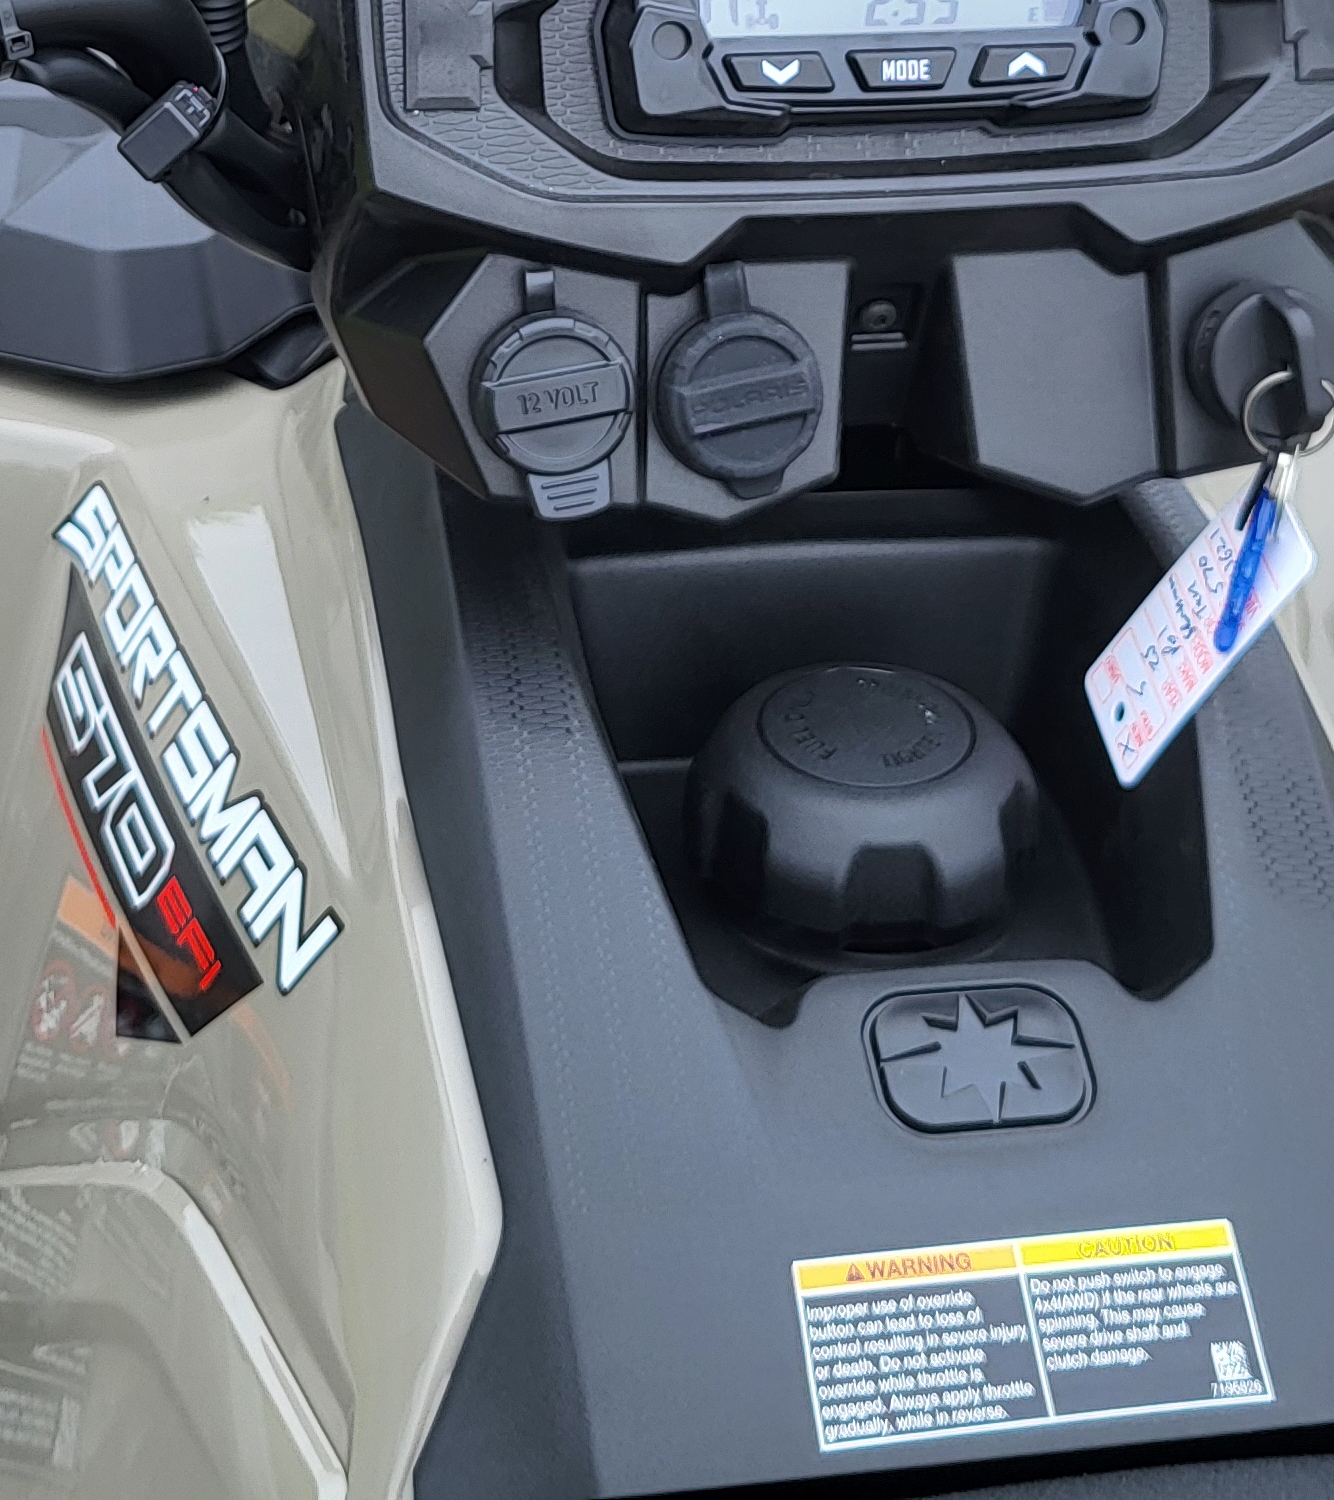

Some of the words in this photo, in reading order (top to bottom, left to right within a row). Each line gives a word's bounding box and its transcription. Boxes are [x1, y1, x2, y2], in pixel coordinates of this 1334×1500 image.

[881, 58, 931, 81] MODE
[517, 392, 541, 415] 12
[544, 381, 599, 407] VOLT
[55, 482, 341, 995] SPORTSMAN
[156, 874, 223, 992] EFI
[1075, 1232, 1176, 1259] CAUTION
[866, 1252, 972, 1279] WARNING
[1030, 1277, 1051, 1293] Do
[1051, 1275, 1075, 1291] not
[1076, 1271, 1113, 1292] push
[1111, 1267, 1157, 1285] switch
[1157, 1265, 1173, 1280] to
[1174, 1263, 1228, 1283] engage
[806, 1299, 870, 1323] Improper
[871, 1299, 898, 1313] use
[899, 1294, 915, 1310] of
[915, 1288, 975, 1308] override
[1100, 1290, 1111, 1305] if
[1112, 1287, 1137, 1304] the
[1136, 1287, 1164, 1301] rear
[1166, 1279, 1214, 1298] wheels
[1214, 1280, 1238, 1293] are
[809, 1320, 855, 1339] button
[857, 1320, 883, 1334] can
[885, 1313, 917, 1331] lead
[918, 1312, 934, 1328] to
[936, 1309, 964, 1326] loss
[965, 1307, 983, 1323] of
[1101, 1307, 1132, 1324] This
[1131, 1306, 1163, 1325] may
[1162, 1302, 1207, 1318] cause
[812, 1338, 862, 1358] control
[863, 1332, 924, 1357] resulting
[925, 1330, 940, 1346] in
[941, 1328, 989, 1345] severe
[989, 1321, 1028, 1344] injury
[1041, 1334, 1088, 1350] severe
[1088, 1327, 1125, 1345] drive
[1125, 1323, 1162, 1341] shaft
[1160, 1320, 1191, 1337] and
[815, 1365, 830, 1378] or
[878, 1354, 902, 1372] Do
[902, 1352, 927, 1369] not
[928, 1345, 986, 1366] activate
[1045, 1350, 1090, 1369] clutch
[818, 1377, 877, 1399] override
[877, 1373, 916, 1392] while
[916, 1367, 968, 1388] throttle
[969, 1366, 984, 1382] is
[887, 1390, 941, 1415] Always
[941, 1386, 982, 1409] apply
[982, 1380, 1035, 1400] throttle
[895, 1411, 934, 1431] while
[936, 1409, 950, 1426] in
